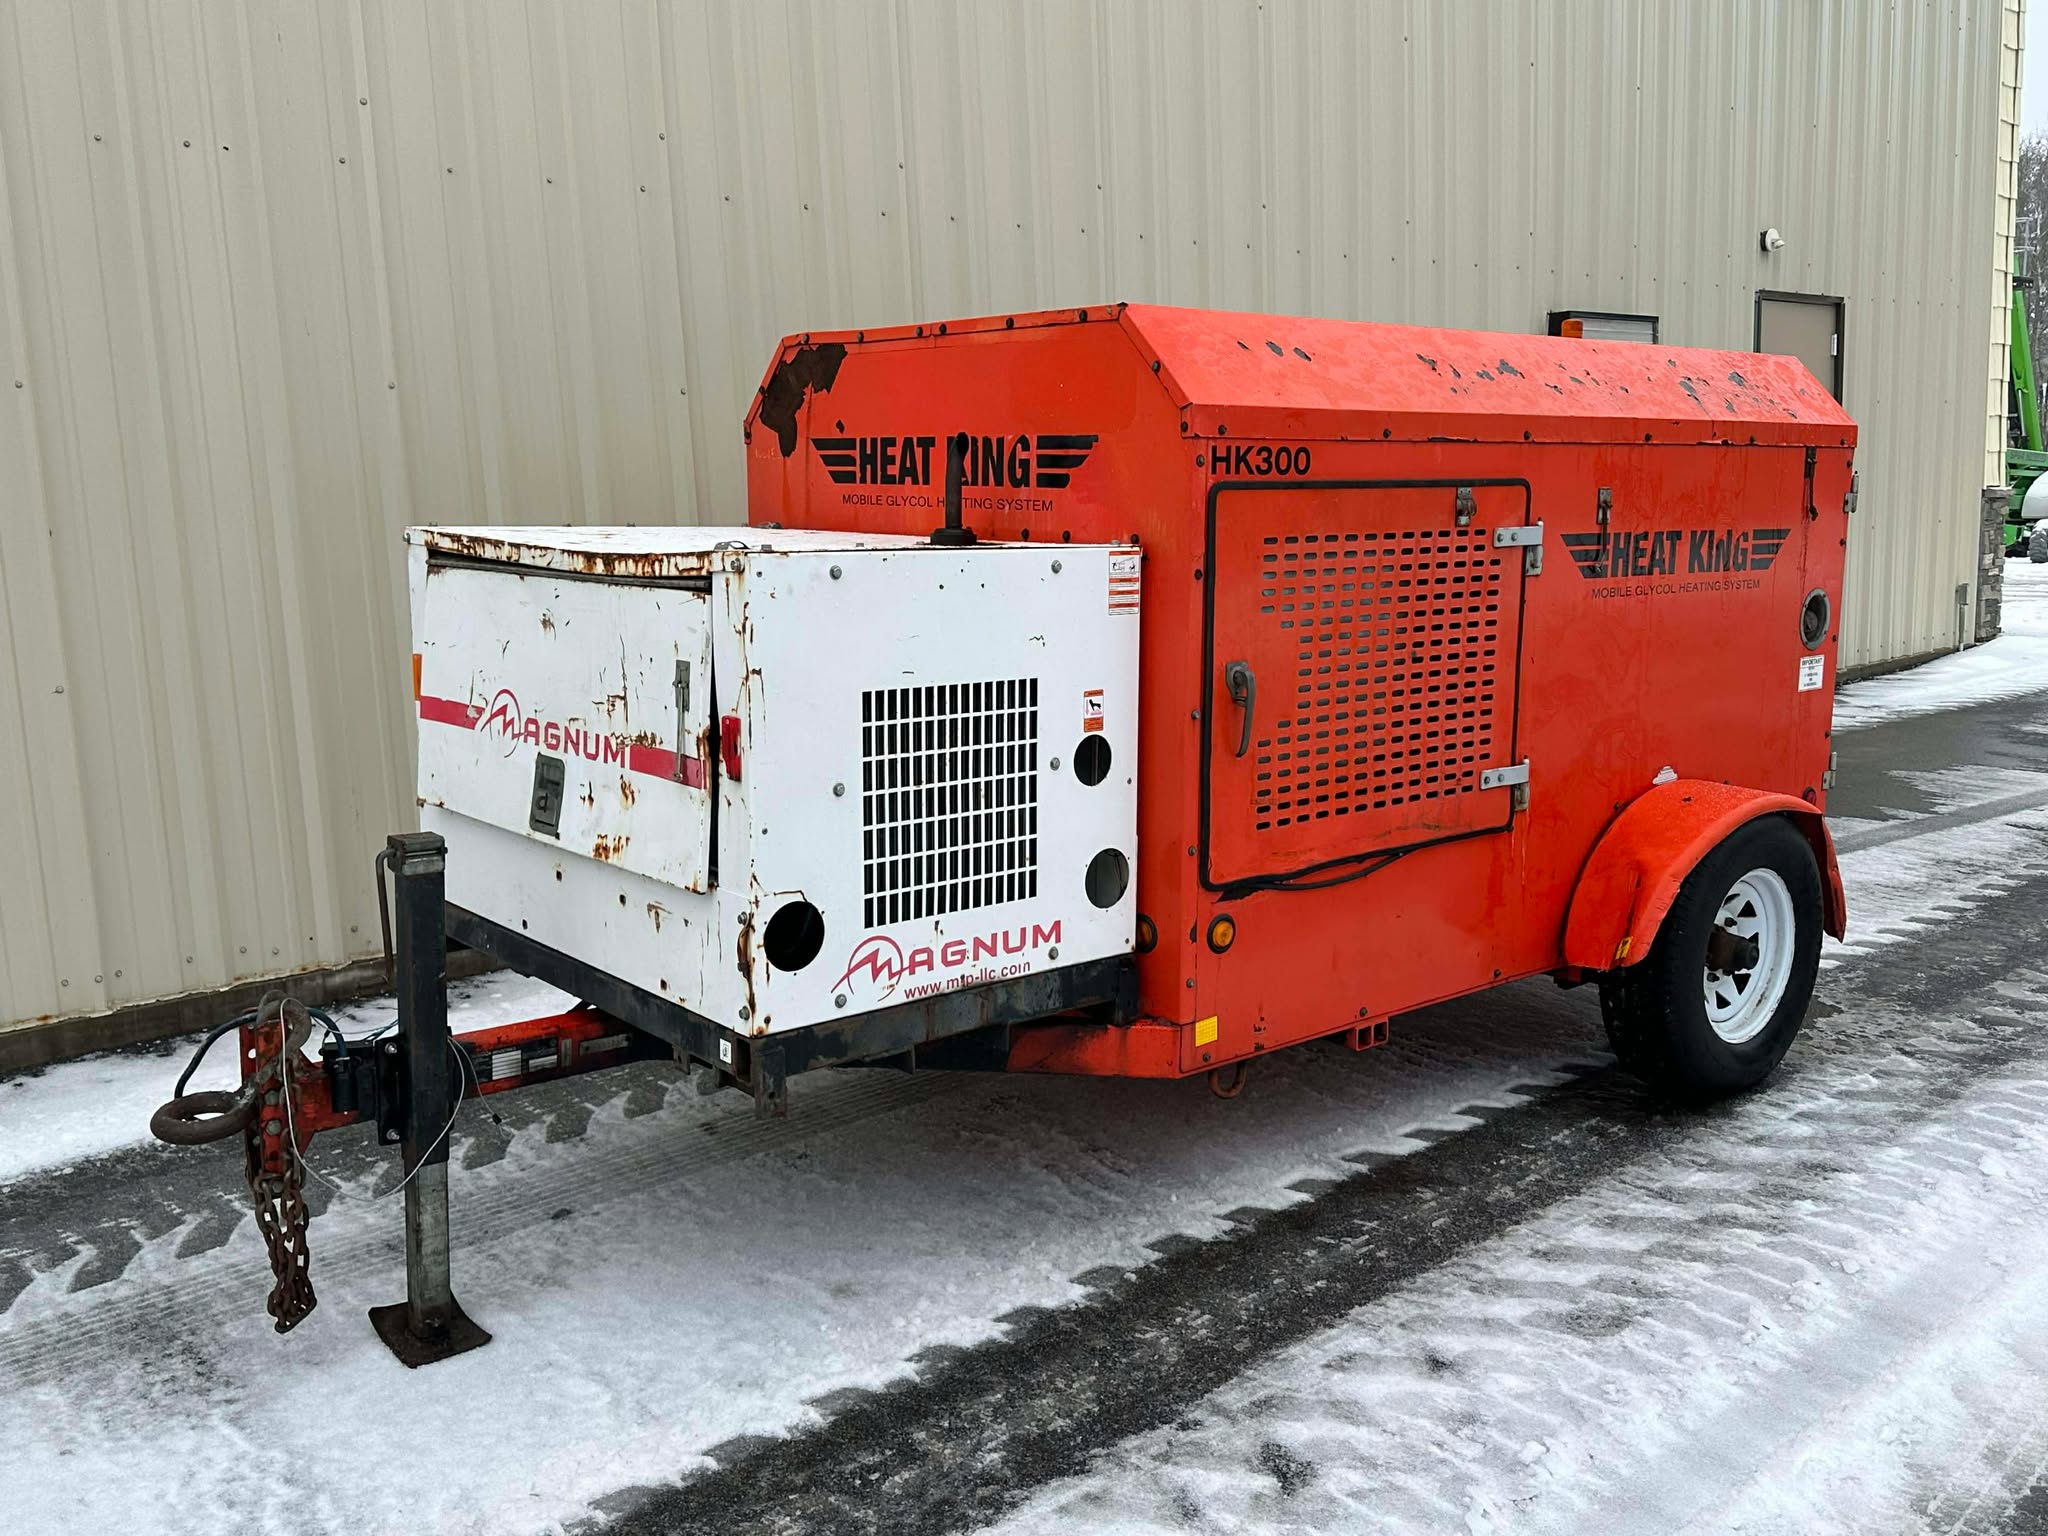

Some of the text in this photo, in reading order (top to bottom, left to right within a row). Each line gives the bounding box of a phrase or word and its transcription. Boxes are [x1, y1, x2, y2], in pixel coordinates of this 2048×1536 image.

[859, 436, 936, 485] HEAT
[1211, 445, 1311, 475] HK300
[842, 493, 1053, 511] MOBILE GLYCOL HTING SYSTEM
[1611, 529, 1749, 577] HEAT KING
[1592, 578, 1760, 599] MOBILE GLYCOL HEATING SYSTEM
[480, 698, 626, 768] MAGNUM
[831, 920, 1062, 995] MAGNUM
